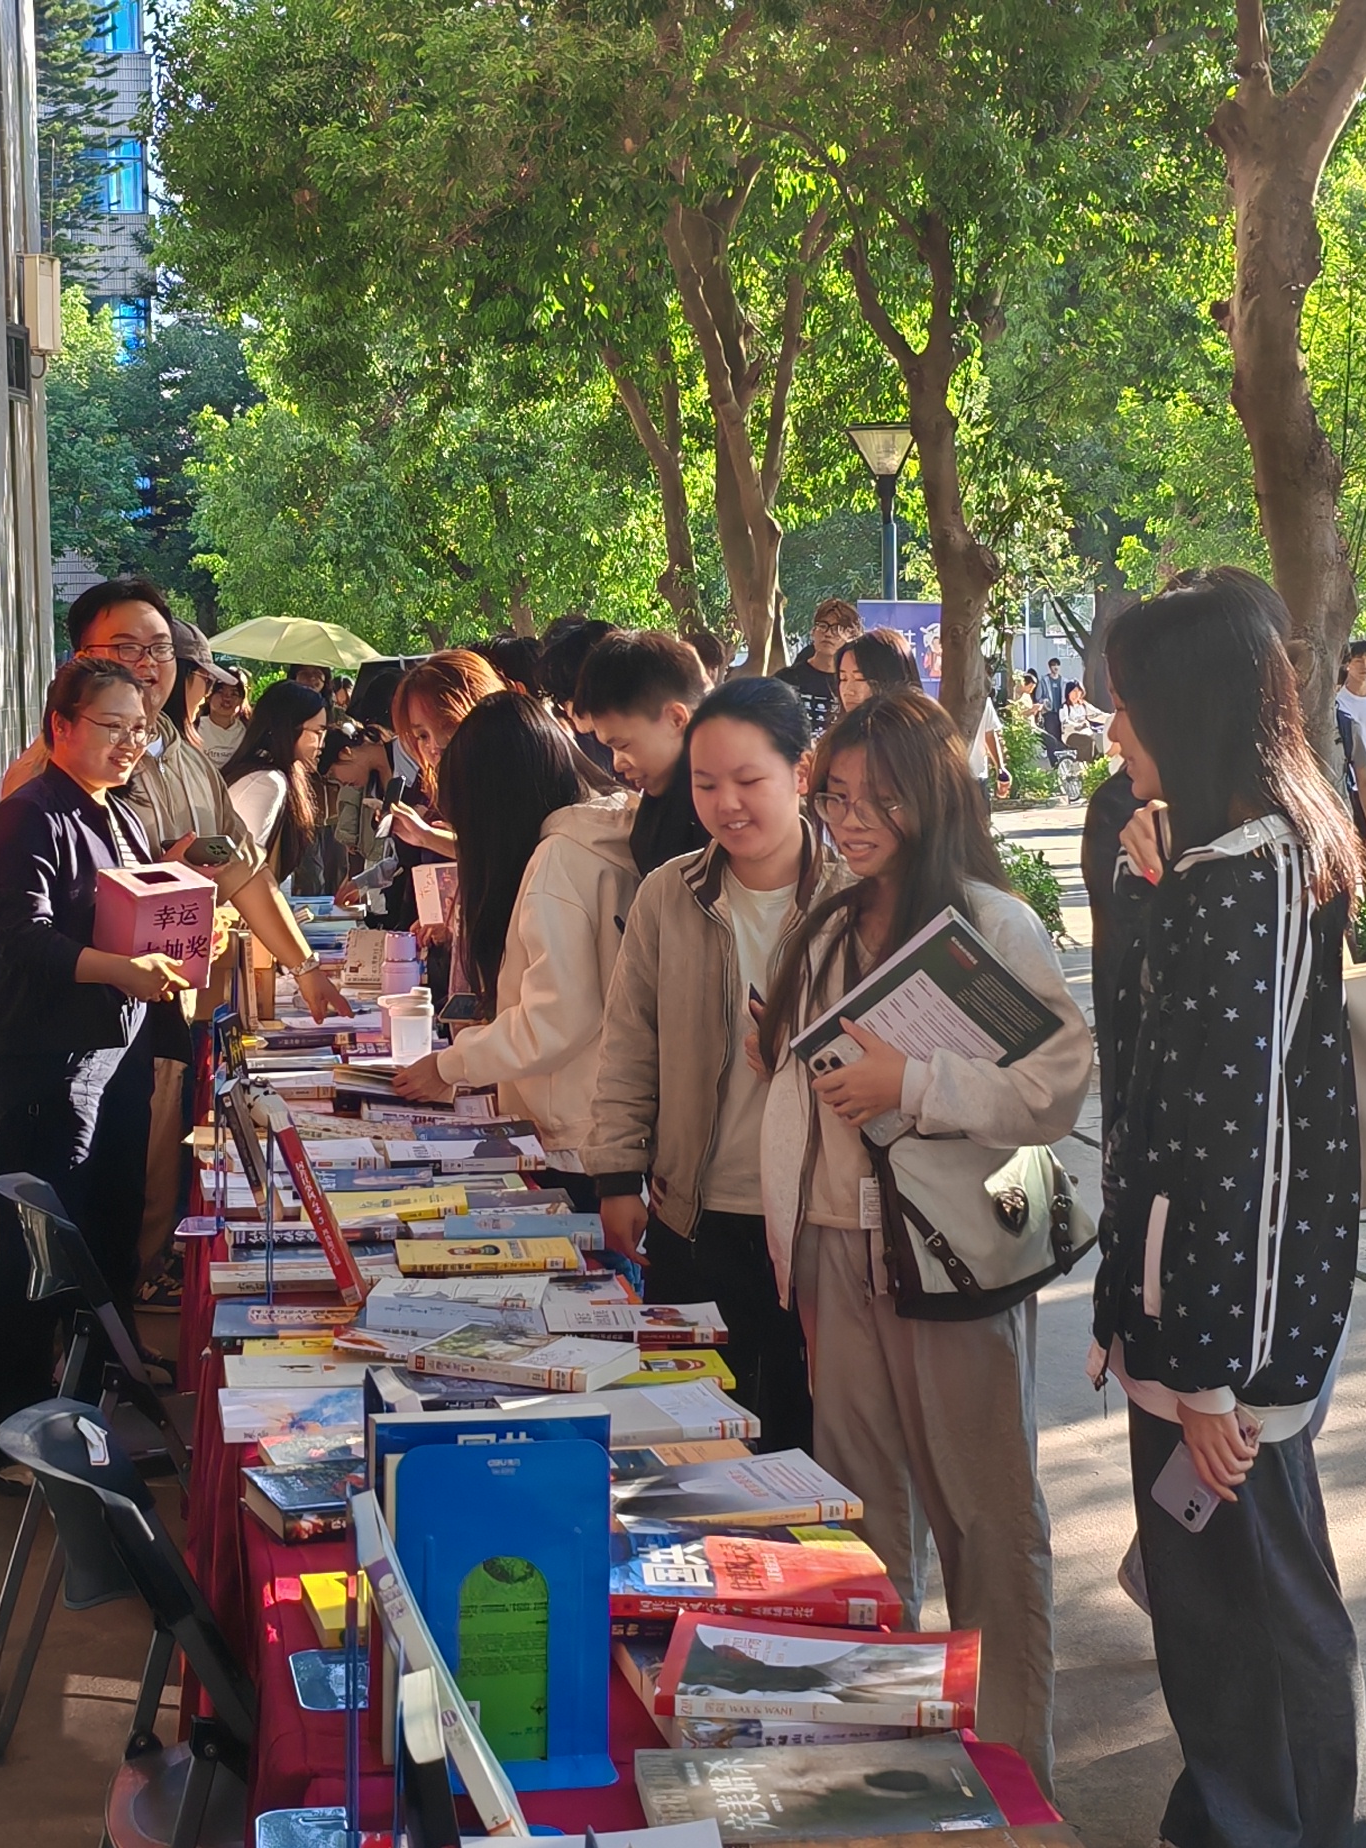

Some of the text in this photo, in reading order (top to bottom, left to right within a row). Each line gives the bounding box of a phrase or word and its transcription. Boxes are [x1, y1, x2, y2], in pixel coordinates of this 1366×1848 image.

[153, 902, 199, 930] 幸运
[702, 1757, 783, 1832] 完美猎杀
